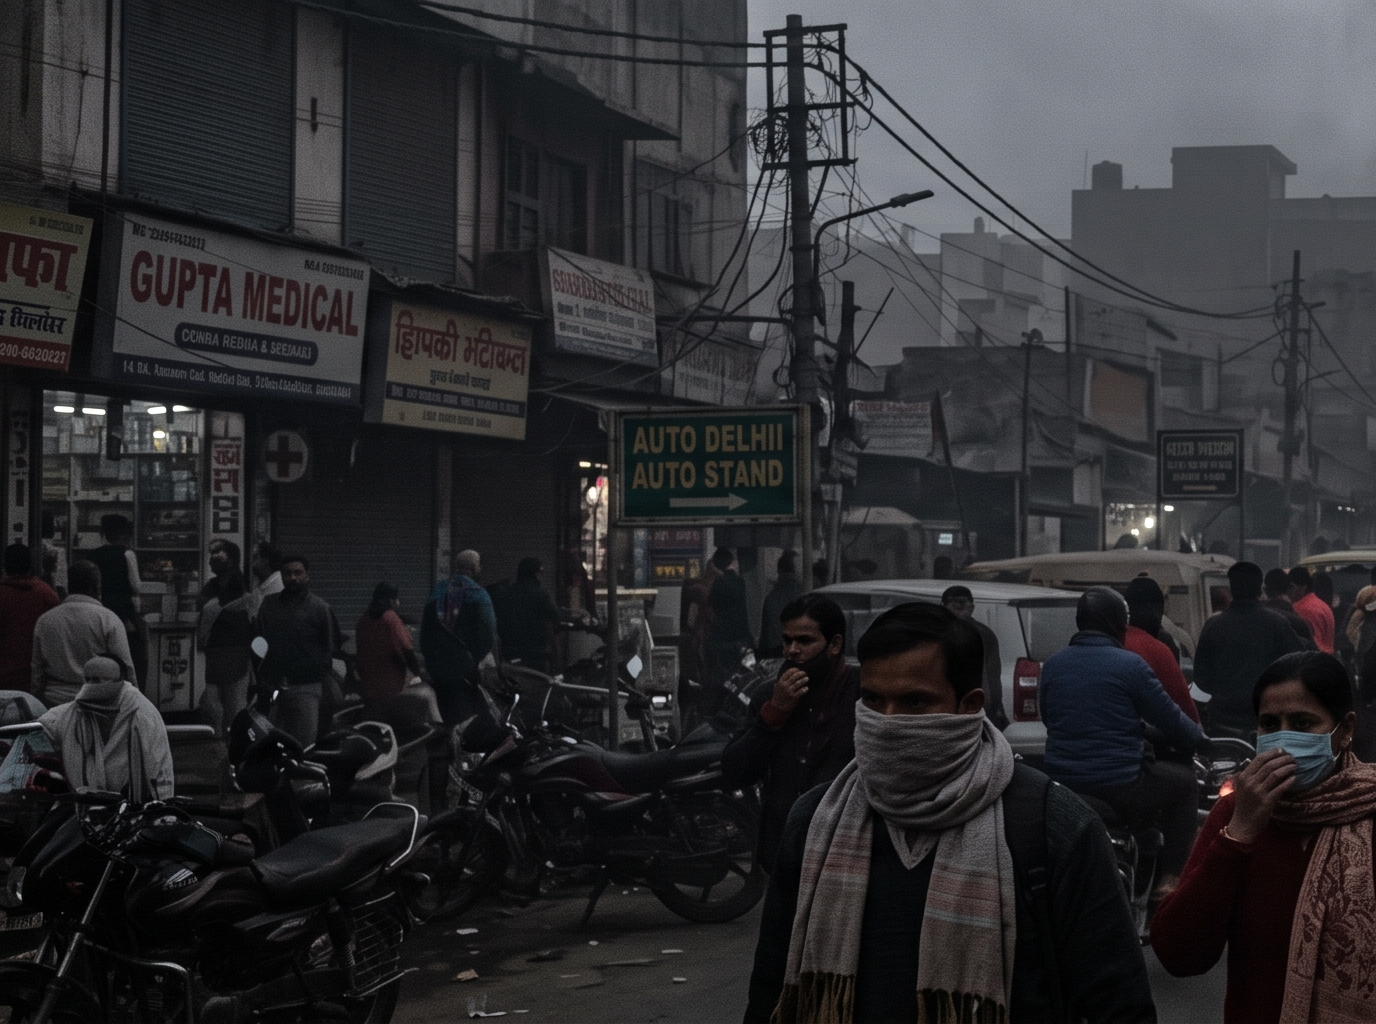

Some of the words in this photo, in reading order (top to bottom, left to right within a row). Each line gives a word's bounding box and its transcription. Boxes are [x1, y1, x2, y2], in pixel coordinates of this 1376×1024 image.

[130, 250, 233, 317] GUPTA
[242, 271, 358, 337] MEDICAL
[633, 426, 697, 454] AUTO
[705, 423, 783, 452] DELHII
[632, 461, 696, 490] AUTO
[704, 459, 784, 488] STAND
